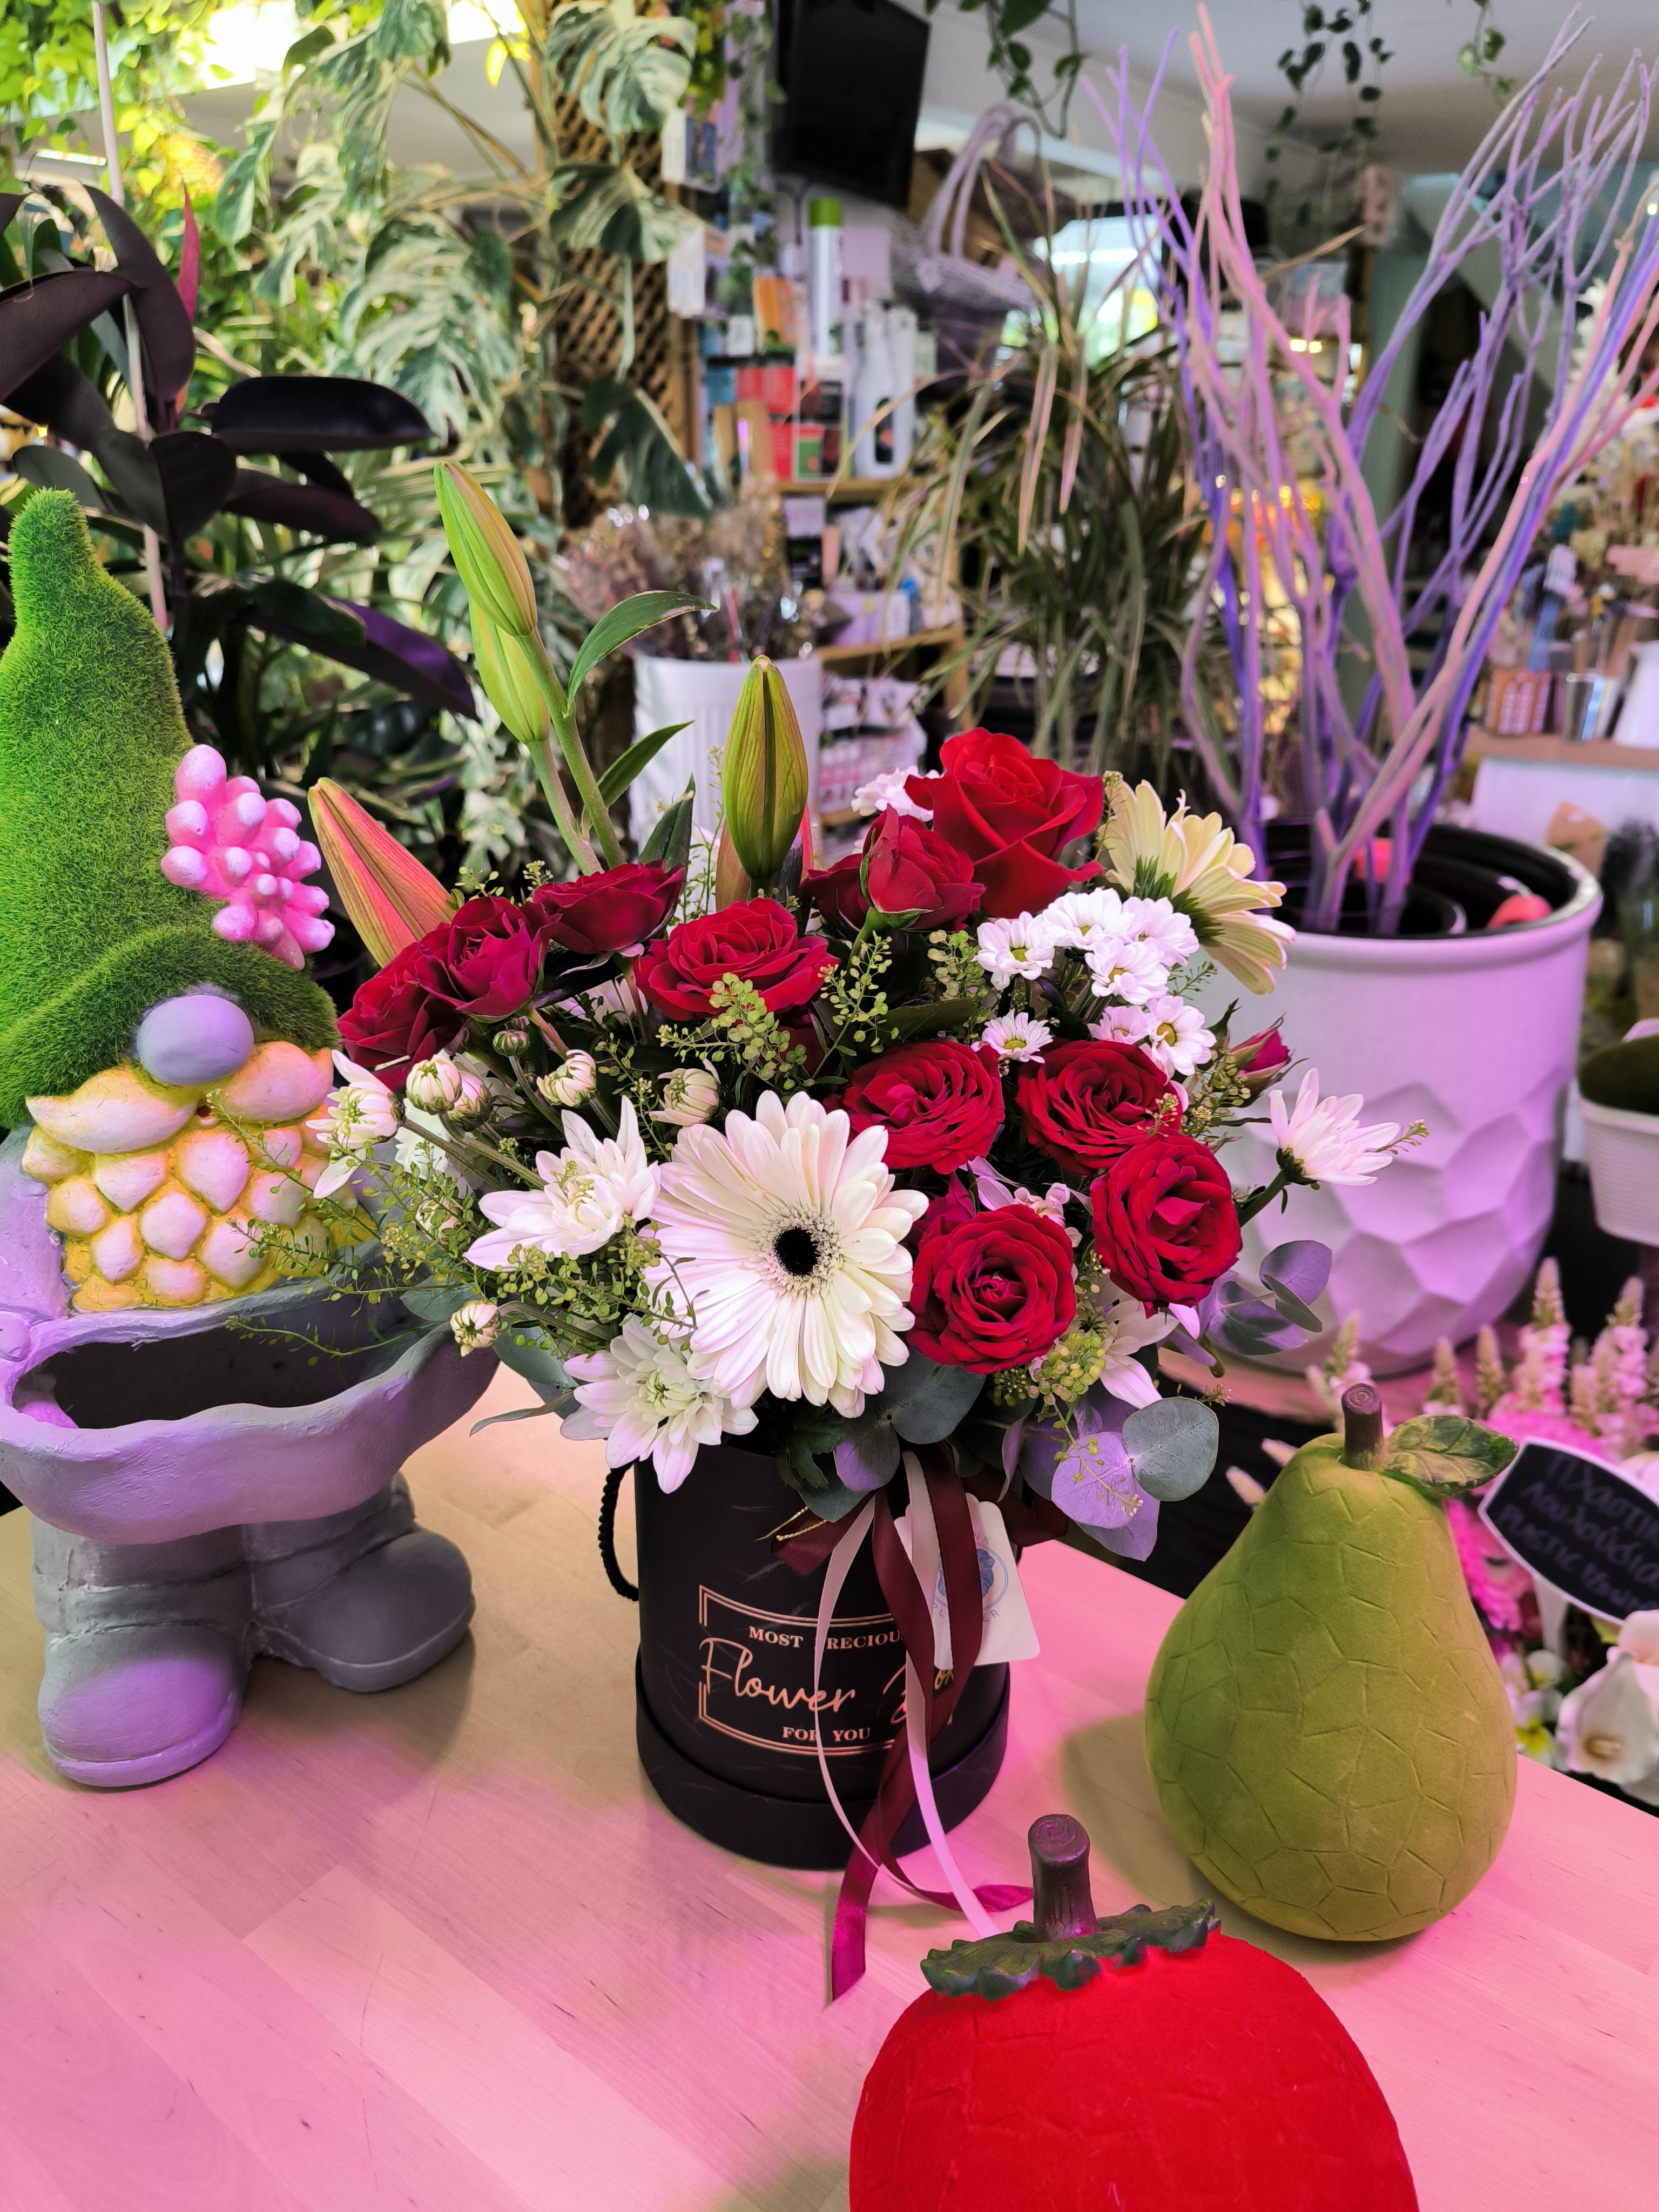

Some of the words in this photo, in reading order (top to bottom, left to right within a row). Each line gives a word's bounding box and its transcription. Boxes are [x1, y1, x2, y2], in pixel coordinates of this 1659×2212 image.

[749, 1626, 804, 1648] MOST
[815, 1630, 901, 1649] RECIOU
[699, 1637, 856, 1712] Flower
[832, 1728, 871, 1742] YOU
